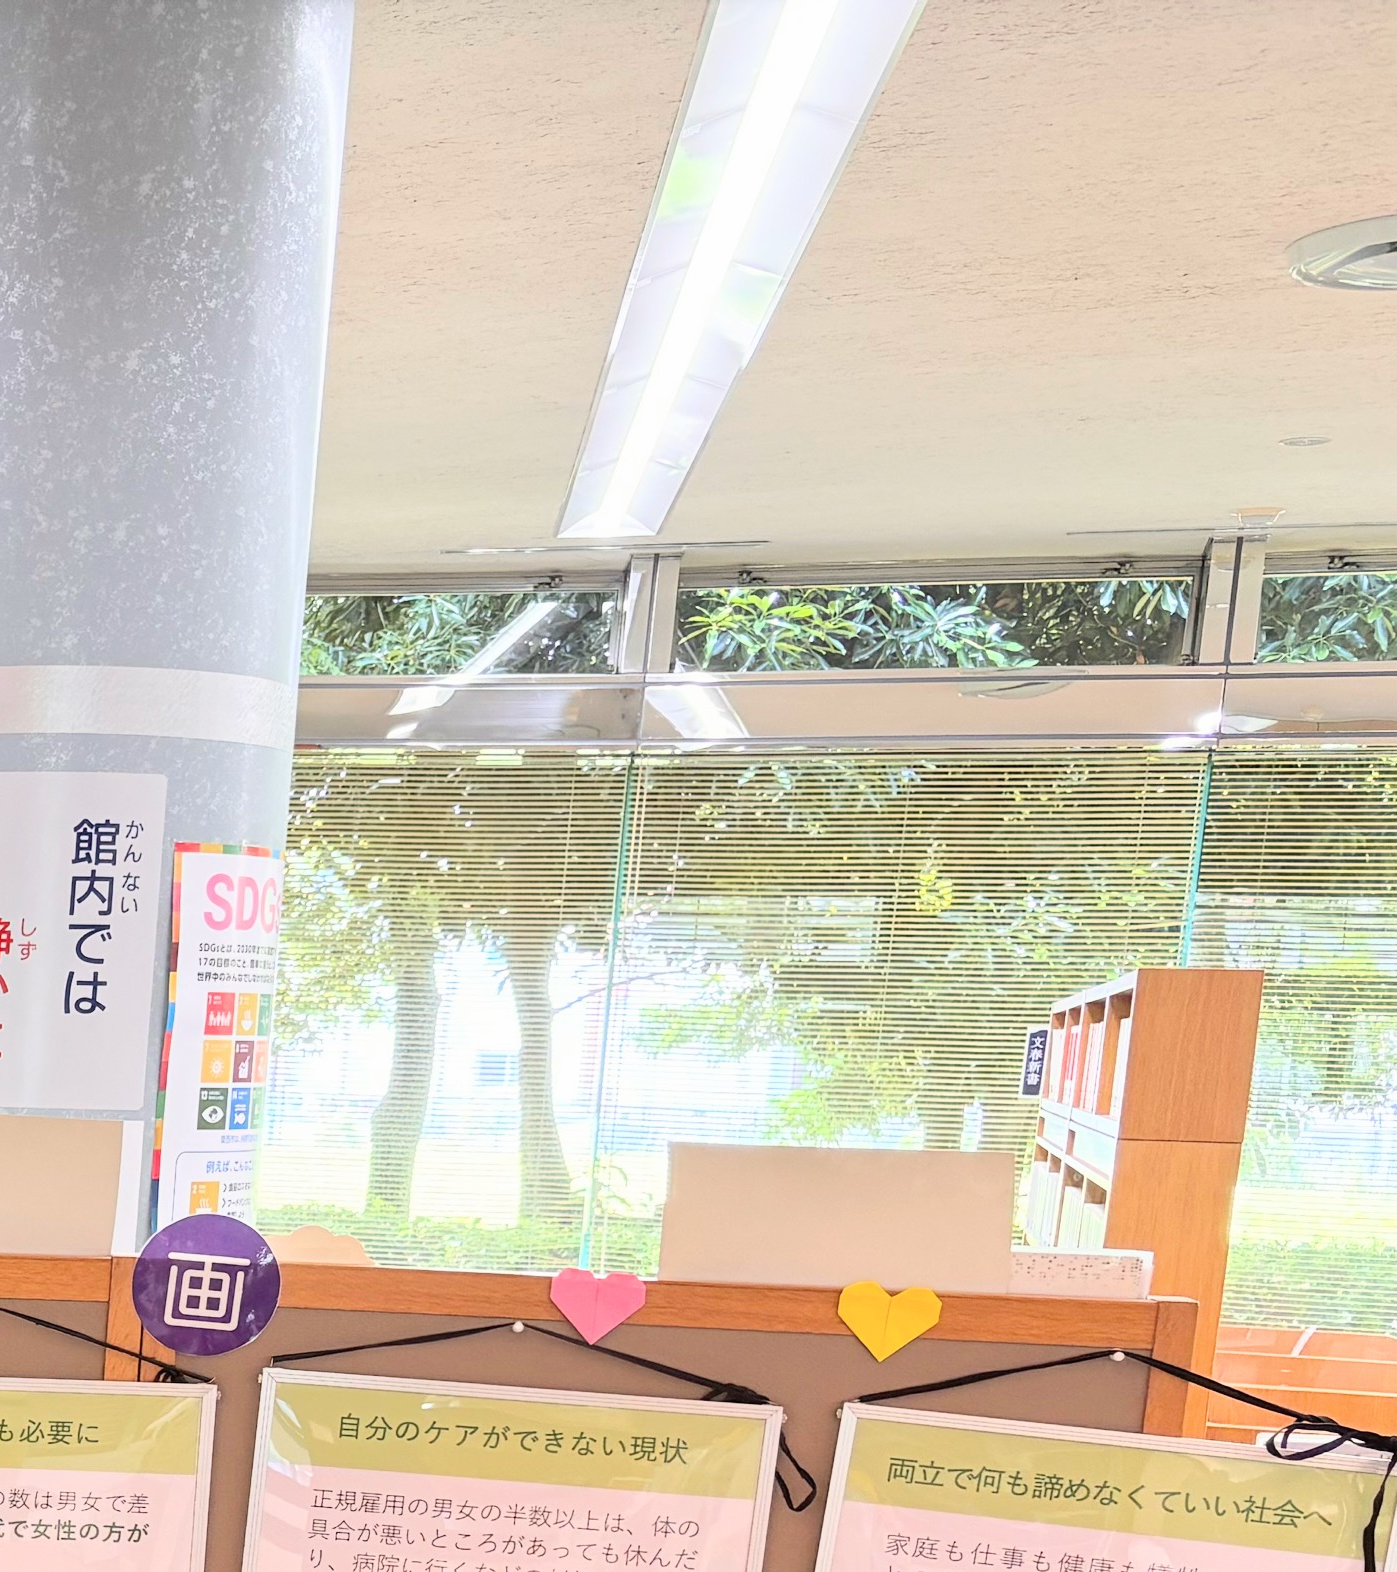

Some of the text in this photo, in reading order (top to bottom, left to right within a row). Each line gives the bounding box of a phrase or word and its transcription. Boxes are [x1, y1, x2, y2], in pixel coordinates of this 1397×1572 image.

[19, 918, 37, 961] しず
[63, 818, 119, 1016] 館内では
[1025, 1035, 1045, 1086] 文春新書
[163, 1251, 251, 1331] 画
[337, 1412, 689, 1466] 自分のケアができない現状
[311, 1487, 700, 1540] 正規雇用の男女の半数以上は、体の
[887, 1457, 1333, 1529] 両立で何も諦めなくていい社会へ
[307, 1517, 698, 1572] 具合が悪いところがあっても休んだ
